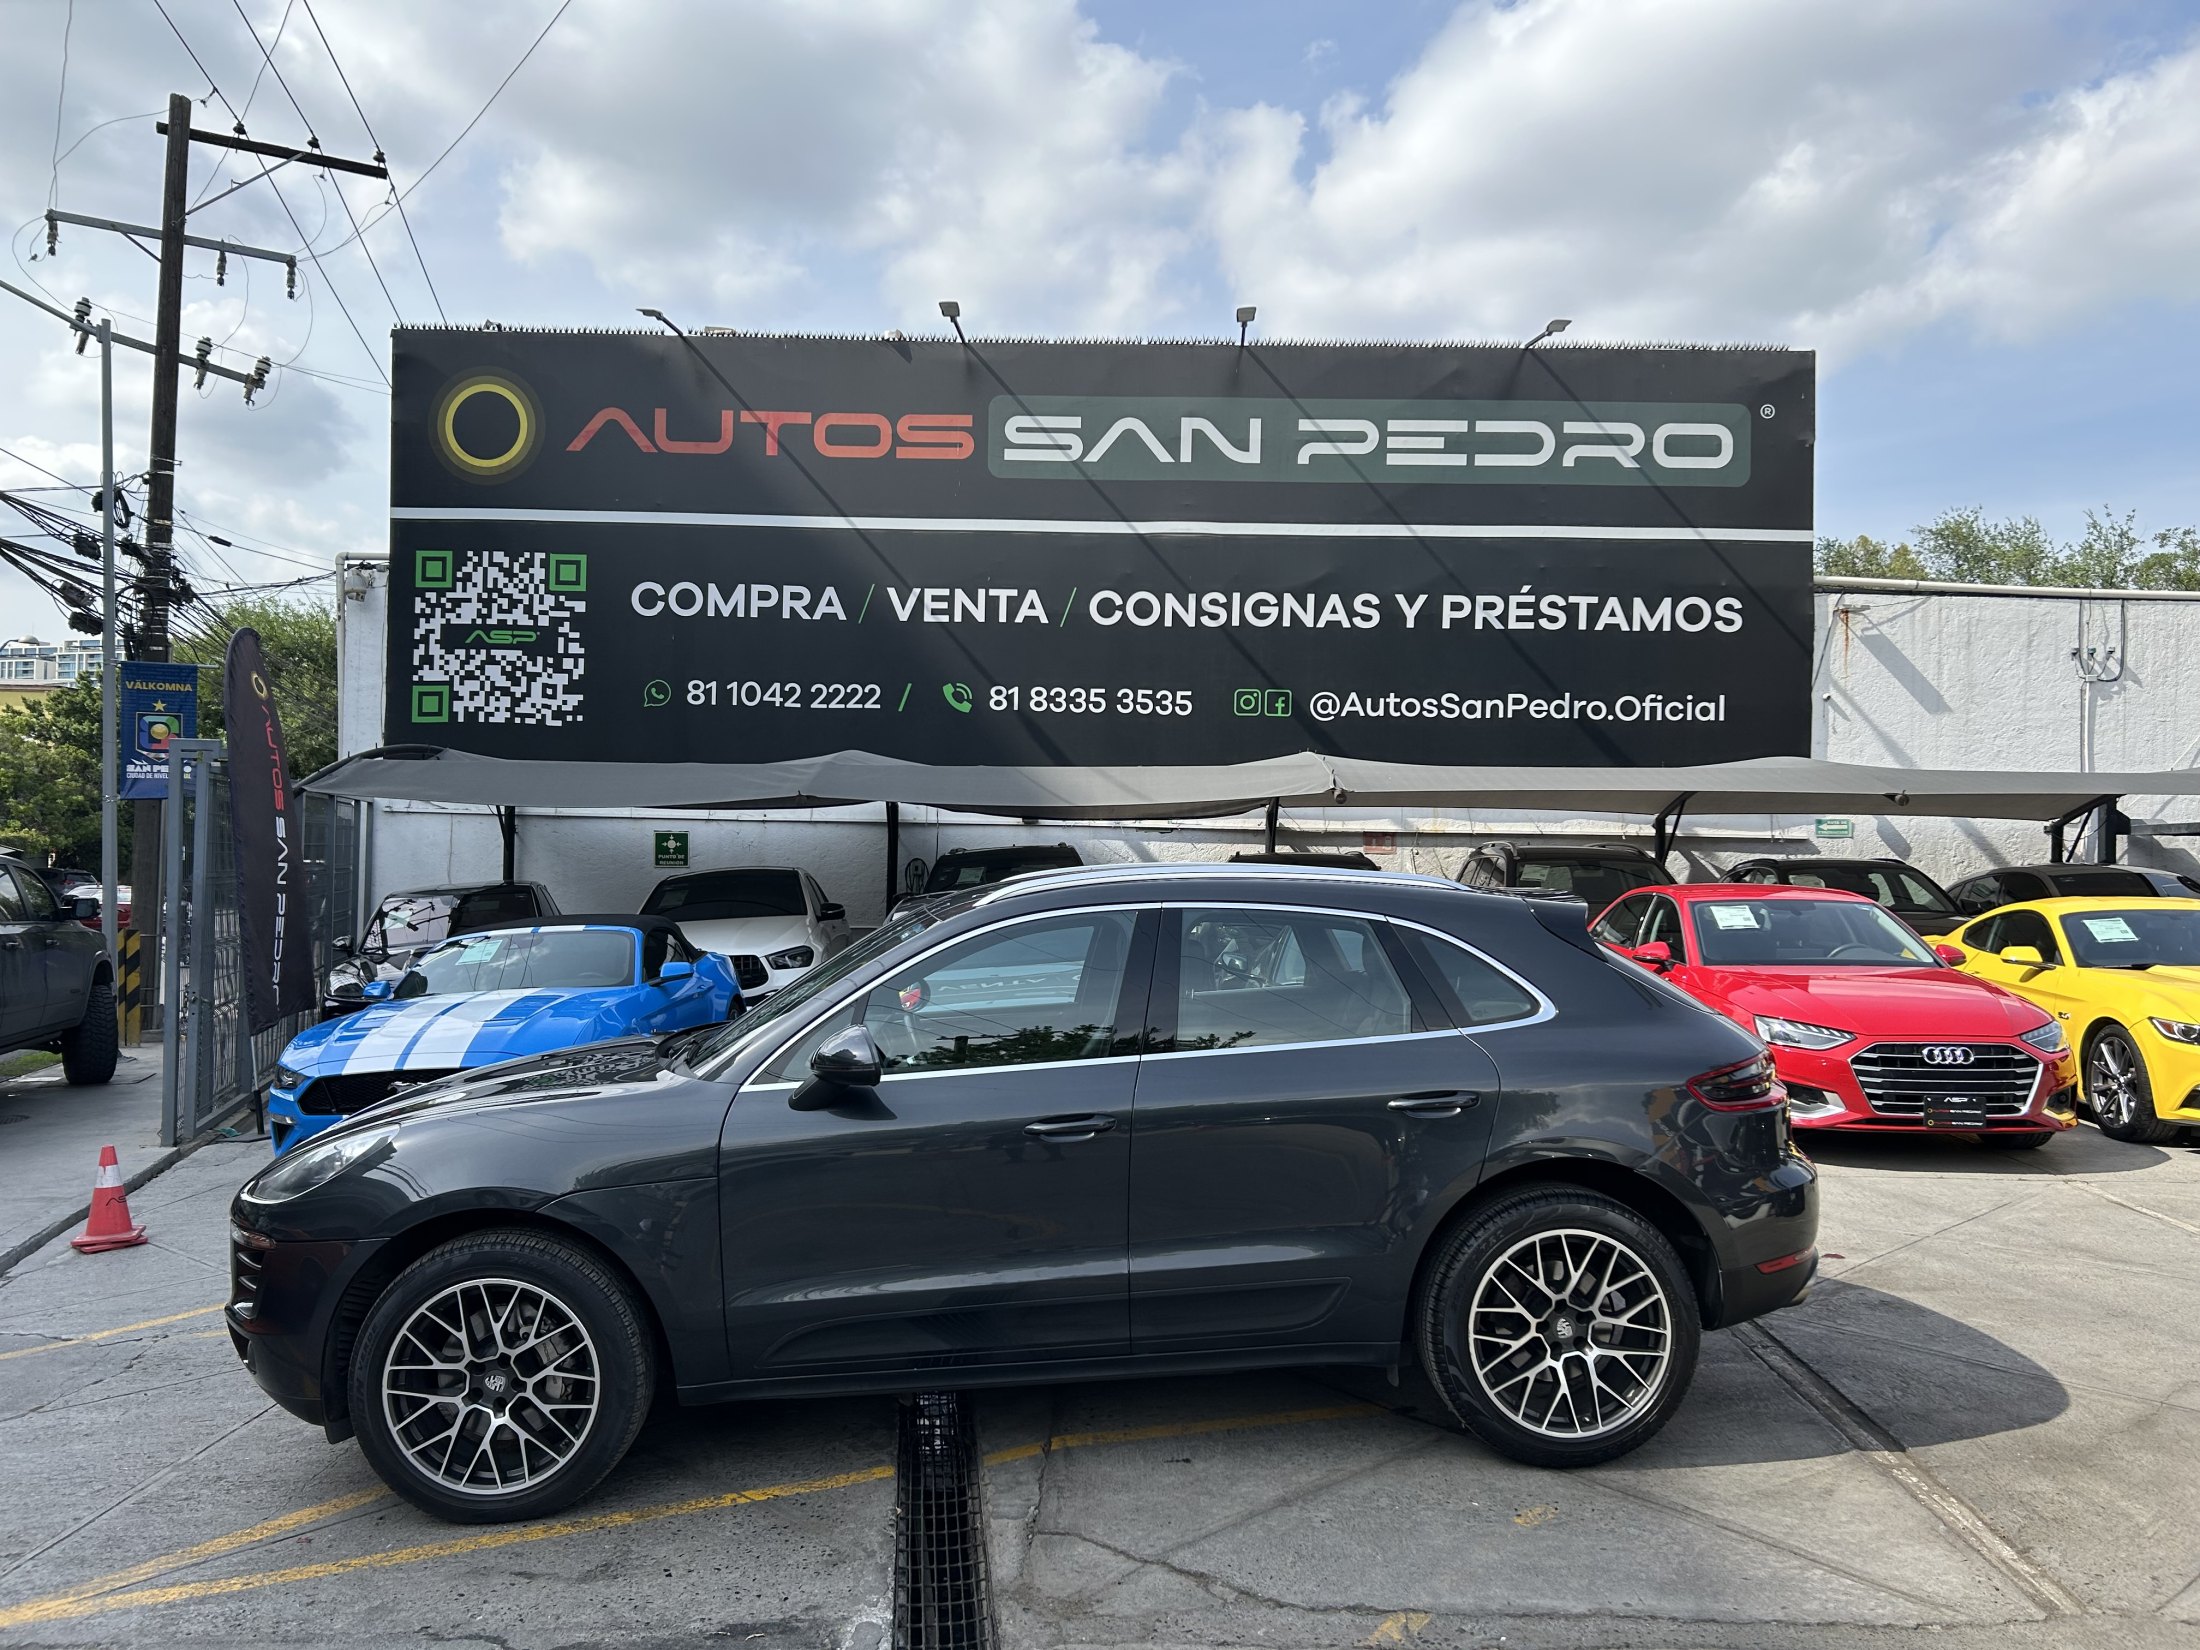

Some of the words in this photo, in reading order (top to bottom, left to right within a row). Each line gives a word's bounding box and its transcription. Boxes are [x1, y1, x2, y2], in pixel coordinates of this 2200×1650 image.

[566, 407, 975, 460] AUTOS
[1004, 415, 1262, 464] SAN
[1298, 418, 1734, 469] PEDRO
[631, 582, 847, 621] COMPRA
[887, 587, 1049, 624] VENTA
[1089, 590, 1381, 629] CONSIGNAS
[1394, 594, 1428, 629] Y
[1442, 585, 1743, 633] PRÉSTAMOS
[464, 629, 537, 645] ASP
[125, 680, 193, 692] VÄLKOMNA
[687, 680, 717, 706] 81
[726, 682, 802, 708] 1042
[810, 684, 881, 709] 2222
[989, 686, 1019, 711] 81
[1029, 687, 1107, 714] 8335
[1116, 689, 1193, 716] 3535
[1309, 691, 1726, 723] @AutosSanPedro.Oficial
[126, 764, 152, 773] SAN
[261, 704, 285, 811] AUTOS
[274, 816, 289, 885] SAN
